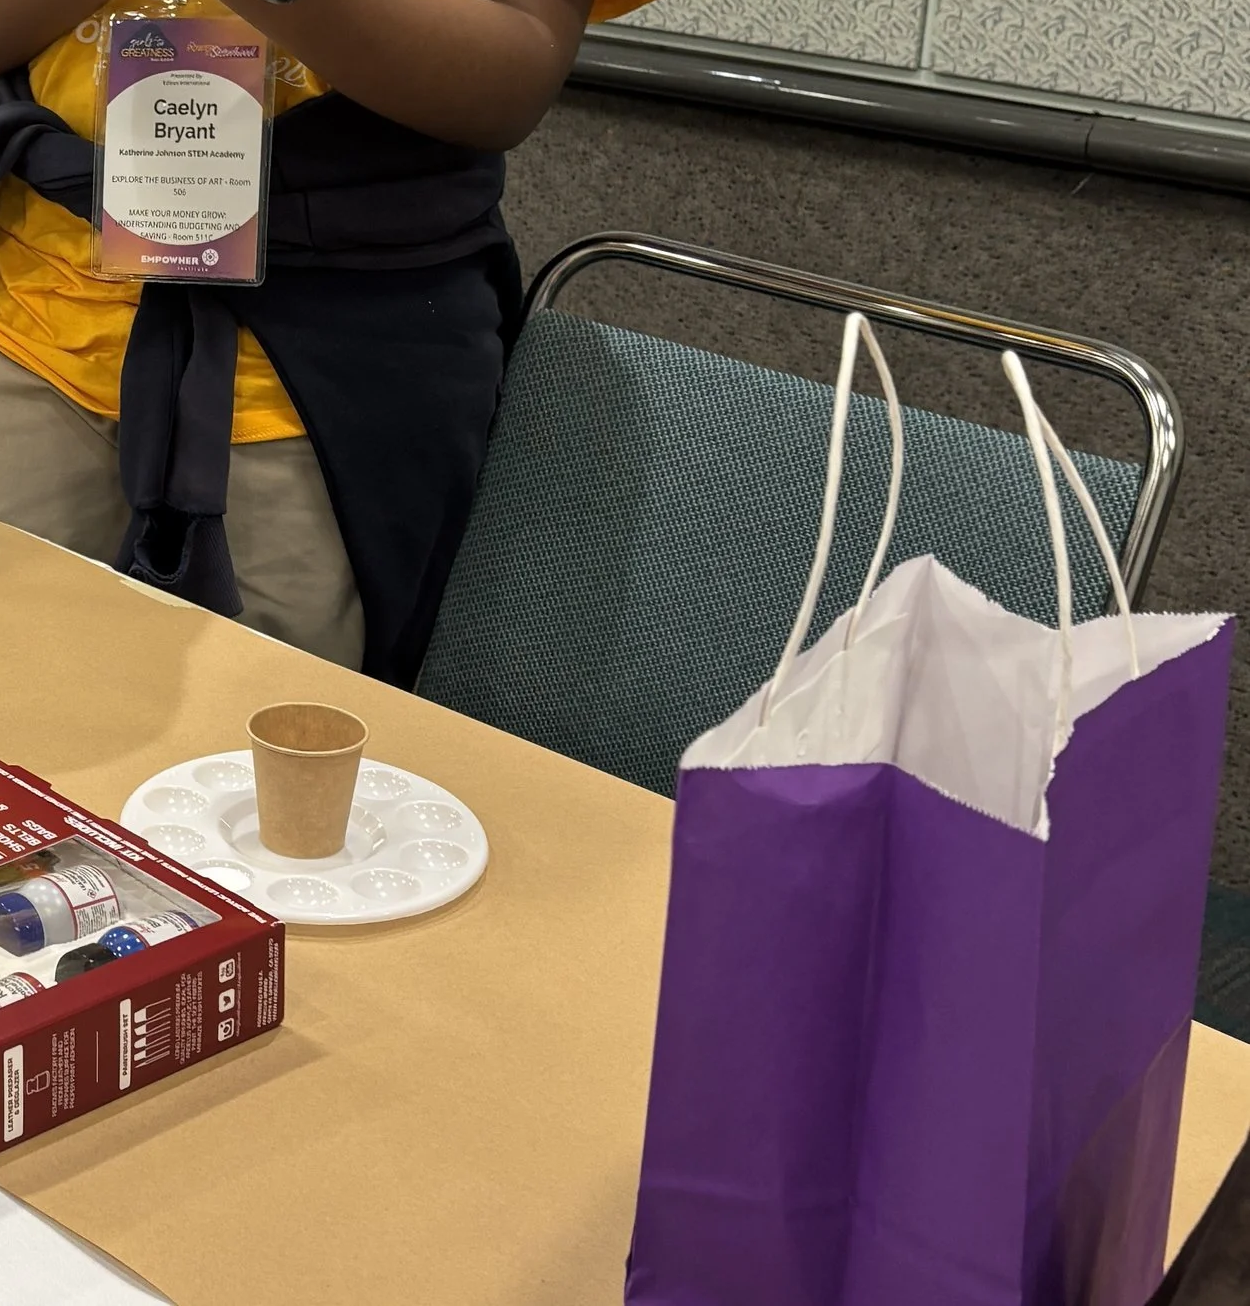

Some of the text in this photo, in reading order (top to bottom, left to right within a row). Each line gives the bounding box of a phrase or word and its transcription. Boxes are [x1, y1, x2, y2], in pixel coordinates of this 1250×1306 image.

[154, 99, 217, 120] Caelyn
[154, 123, 216, 143] Bryant
[119, 148, 245, 159] Katherine Johnson STEM Academy
[112, 175, 251, 186] EXPLORE THE BUSINESS OF ART Room
[129, 209, 149, 217] MAKE
[151, 209, 171, 217] YOUR
[173, 210, 200, 218] MONEY
[179, 222, 222, 231] BUDGETING
[223, 223, 240, 231] AND
[140, 232, 167, 240] SAVING
[173, 233, 194, 242] Room
[2, 824, 42, 846] BELTS
[22, 820, 57, 840] BAGS
[119, 849, 144, 861] KIT
